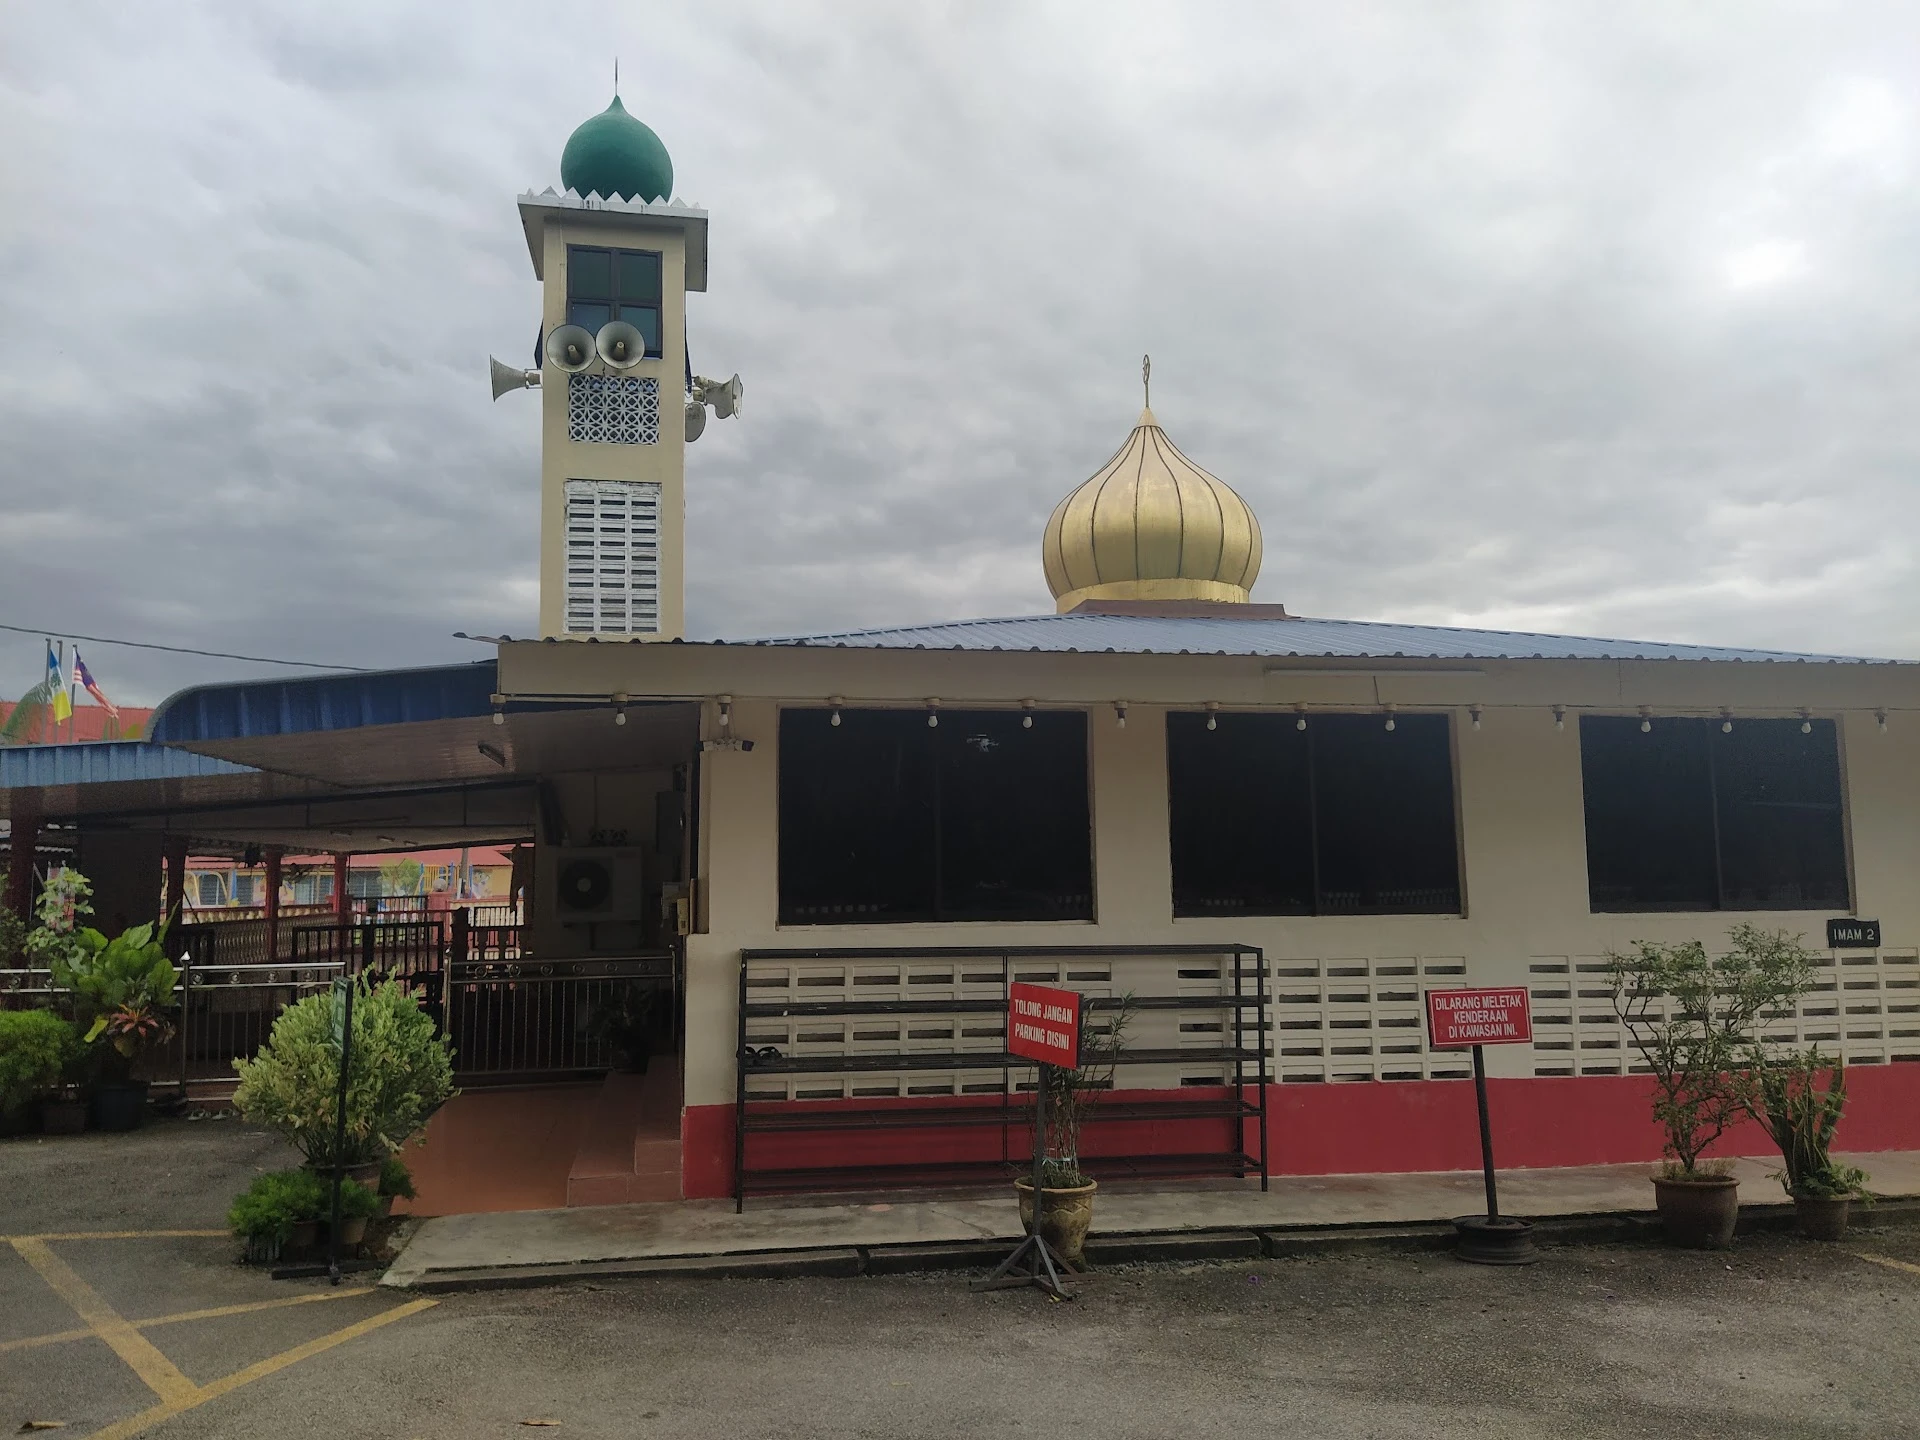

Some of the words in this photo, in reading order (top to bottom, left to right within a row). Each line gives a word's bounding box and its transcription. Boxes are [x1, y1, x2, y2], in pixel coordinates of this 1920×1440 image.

[1833, 928, 1862, 940] IMAM
[1867, 928, 1875, 940] 2
[1435, 995, 1480, 1010] DILARANG
[1482, 994, 1522, 1008] MELETAK
[1014, 999, 1042, 1018] TOLONG
[1043, 1005, 1073, 1024] JANGAN
[1454, 1010, 1508, 1023] KENDERAAN
[1014, 1023, 1045, 1044] PARKING
[1046, 1030, 1069, 1050] DISINI
[1448, 1026, 1458, 1038] DI
[1460, 1024, 1502, 1038] KAWASAN
[1504, 1024, 1518, 1036] INI.
